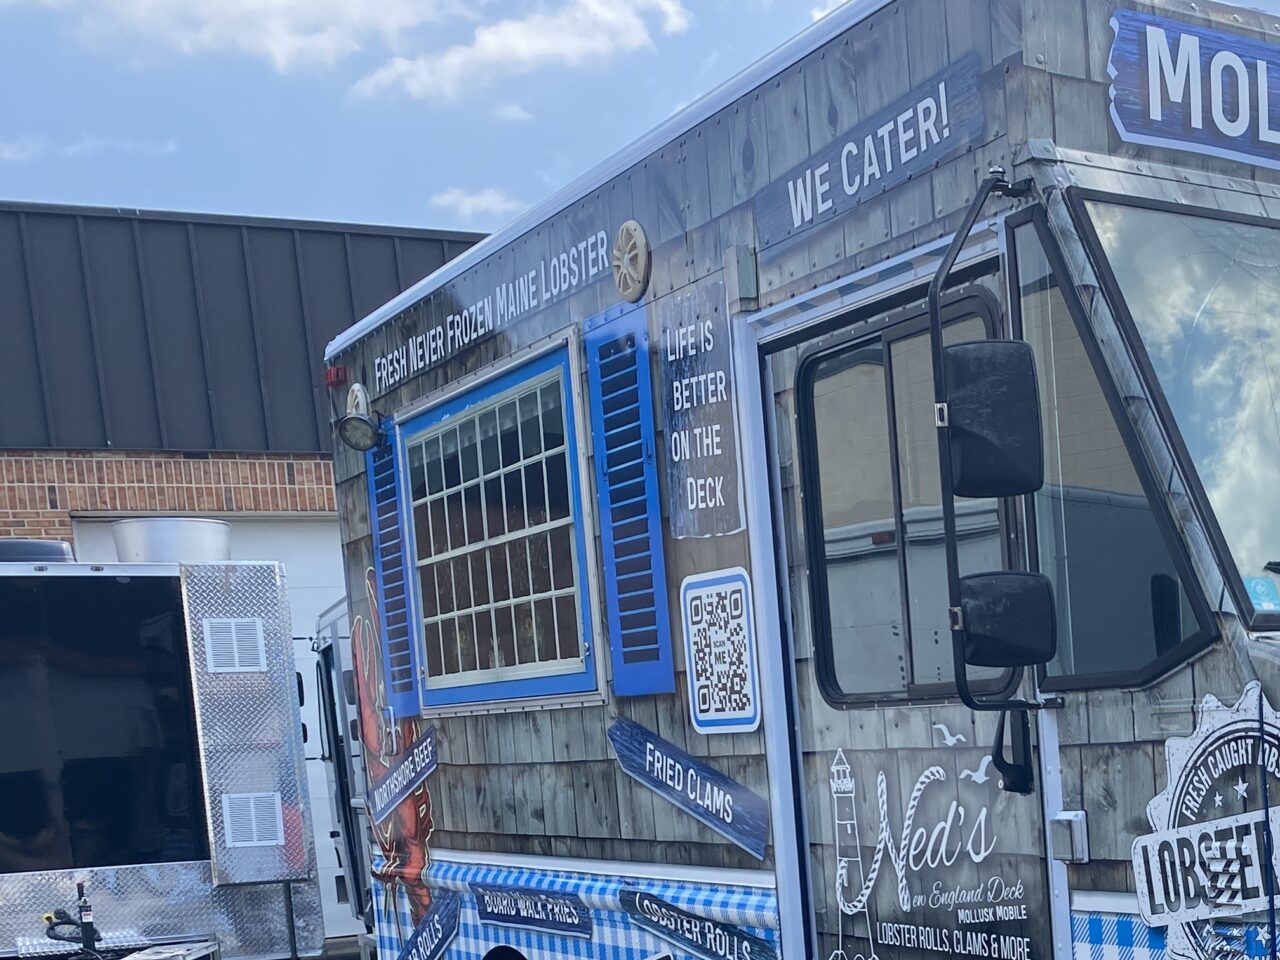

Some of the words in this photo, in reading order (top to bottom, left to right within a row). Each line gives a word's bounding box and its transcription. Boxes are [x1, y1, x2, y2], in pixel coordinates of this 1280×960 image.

[787, 162, 833, 228] WE
[841, 81, 949, 195] CATER!
[374, 345, 407, 392] FRESH
[409, 325, 445, 373] NEVER
[447, 296, 493, 353] FROZEN
[495, 270, 538, 326] MAINE
[540, 230, 609, 299] LOBSTER
[667, 325, 697, 361] LIFE
[700, 320, 714, 350] IS
[673, 370, 727, 412] BETTER
[671, 429, 690, 462] ON
[695, 424, 722, 457] THE
[686, 476, 725, 510] DECK
[713, 640, 726, 649] SCAN
[714, 652, 727, 666] ME
[374, 755, 416, 812] NORTHSHORE
[413, 737, 433, 773] BEEF
[645, 741, 684, 793] FRIED
[687, 767, 733, 823] CLAMS
[1181, 764, 1212, 822] FRESH
[1207, 739, 1254, 779] CAUGHT
[836, 766, 996, 914] Ned's
[929, 880, 985, 911] England
[987, 876, 1025, 903] Deck
[957, 908, 995, 924] MOLLUSK
[996, 904, 1028, 921] MOBILE
[636, 892, 702, 944] LOBSTER
[877, 922, 917, 949] LOBSTER
[918, 926, 952, 955] ROLLS,
[953, 930, 989, 957] CLAMS
[990, 934, 998, 958] &
